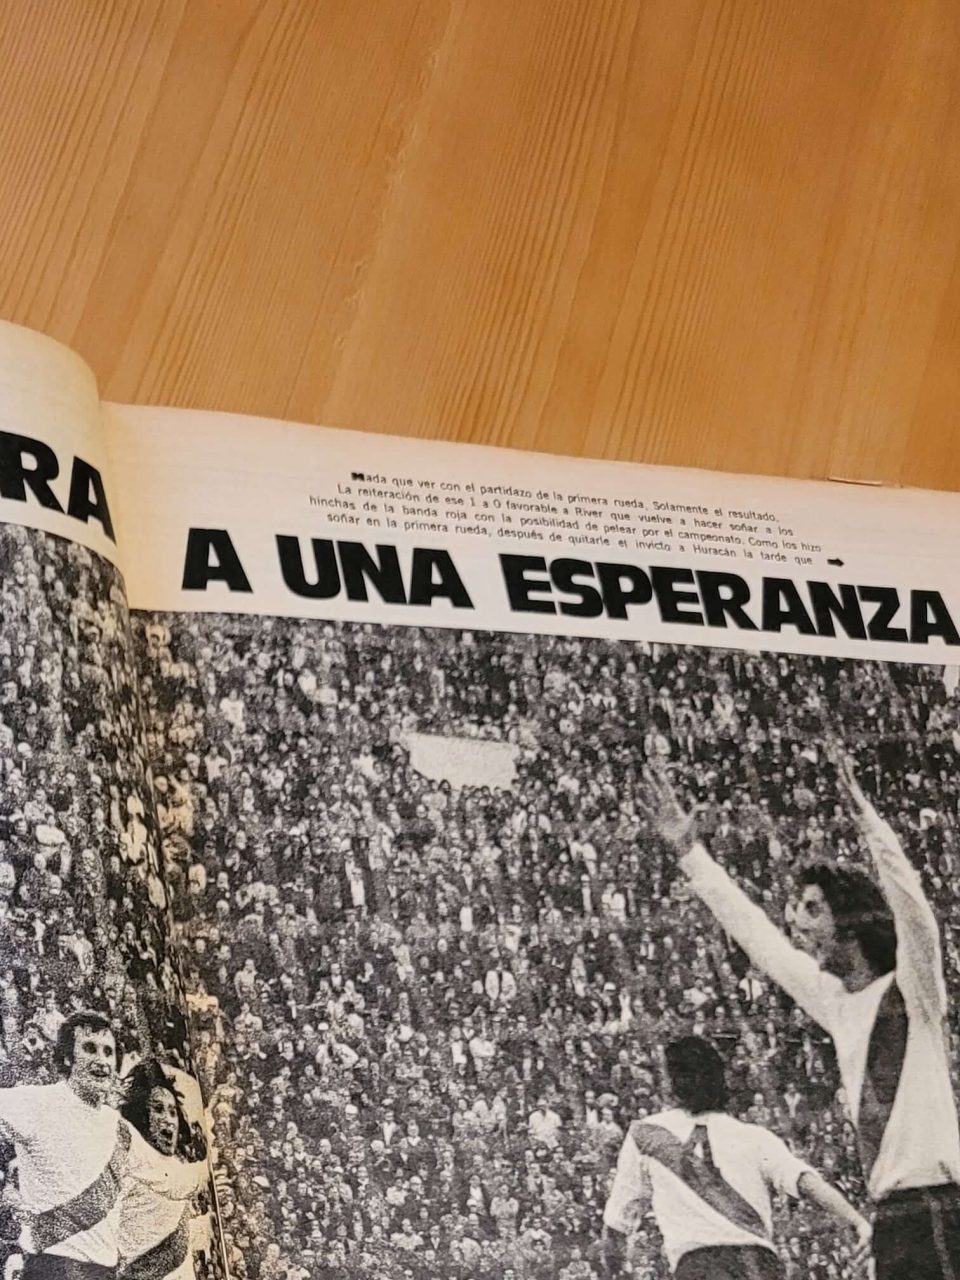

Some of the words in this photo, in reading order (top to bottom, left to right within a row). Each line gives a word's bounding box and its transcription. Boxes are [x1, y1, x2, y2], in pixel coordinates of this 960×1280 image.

[338, 483, 351, 494] La
[358, 487, 420, 502] reiteración
[425, 493, 439, 503] de
[445, 496, 464, 505] ese
[470, 496, 476, 507] 1
[482, 500, 489, 508] a
[493, 498, 501, 508] 0
[506, 499, 558, 514] favorable
[563, 507, 569, 515] a
[575, 506, 603, 518] River
[610, 512, 630, 522] que
[638, 513, 672, 524] vuelve
[680, 517, 686, 525] a
[694, 517, 722, 529] hacer
[729, 522, 758, 533] soñar
[766, 526, 772, 534] a
[778, 525, 793, 536] los
[391, 473, 414, 489] que
[418, 480, 435, 489] ver
[440, 482, 460, 491] con
[465, 482, 475, 492] el
[480, 485, 532, 498] partidazo
[536, 490, 549, 500] de
[553, 490, 563, 501] la
[568, 493, 608, 505] primera
[653, 500, 708, 515] Solamente
[714, 507, 723, 516] el
[310, 495, 356, 510] hinchas
[363, 500, 377, 512] de
[384, 502, 394, 513] la
[402, 504, 438, 517] banda
[445, 509, 467, 521] roja
[475, 513, 495, 522] con
[502, 512, 512, 523] la
[520, 516, 579, 529] posibilidad
[585, 520, 598, 531] de
[604, 523, 636, 534] pelear
[642, 528, 659, 537] por
[664, 528, 673, 537] el
[748, 536, 778, 549] Como
[782, 539, 797, 549] los
[801, 542, 821, 552] hizo
[327, 512, 360, 525] soñar
[366, 517, 380, 526] en
[386, 516, 397, 528] la
[404, 519, 448, 532] primera
[497, 526, 543, 540] después
[549, 531, 562, 541] de
[568, 534, 610, 546] quitarle
[618, 538, 627, 548] el
[636, 539, 671, 551] invicto
[679, 544, 685, 552] a
[693, 543, 736, 557] Huracán
[743, 548, 753, 558] la
[760, 550, 786, 562] tarde
[794, 553, 813, 566] que
[182, 528, 252, 592] A
[276, 535, 474, 608] UNA
[499, 552, 960, 646] ESPERANZA
